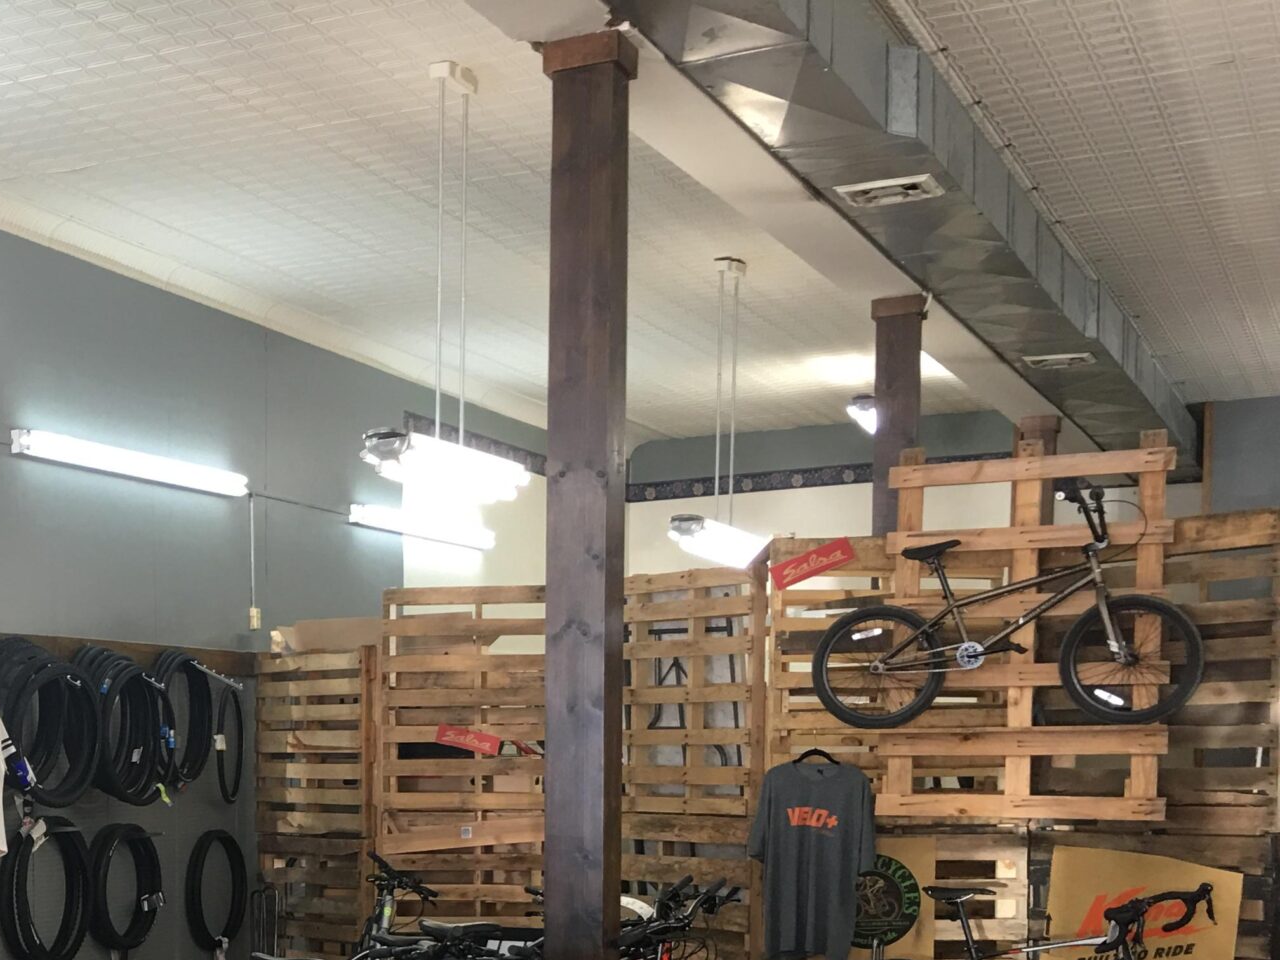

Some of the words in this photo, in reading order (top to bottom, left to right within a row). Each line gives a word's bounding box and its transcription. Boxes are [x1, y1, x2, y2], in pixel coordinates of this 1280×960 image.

[783, 550, 848, 584] Salsa
[441, 730, 491, 751] Salsa
[787, 807, 839, 828] VELO+
[1076, 884, 1188, 938] Kna
[1153, 943, 1195, 959] RIDE
